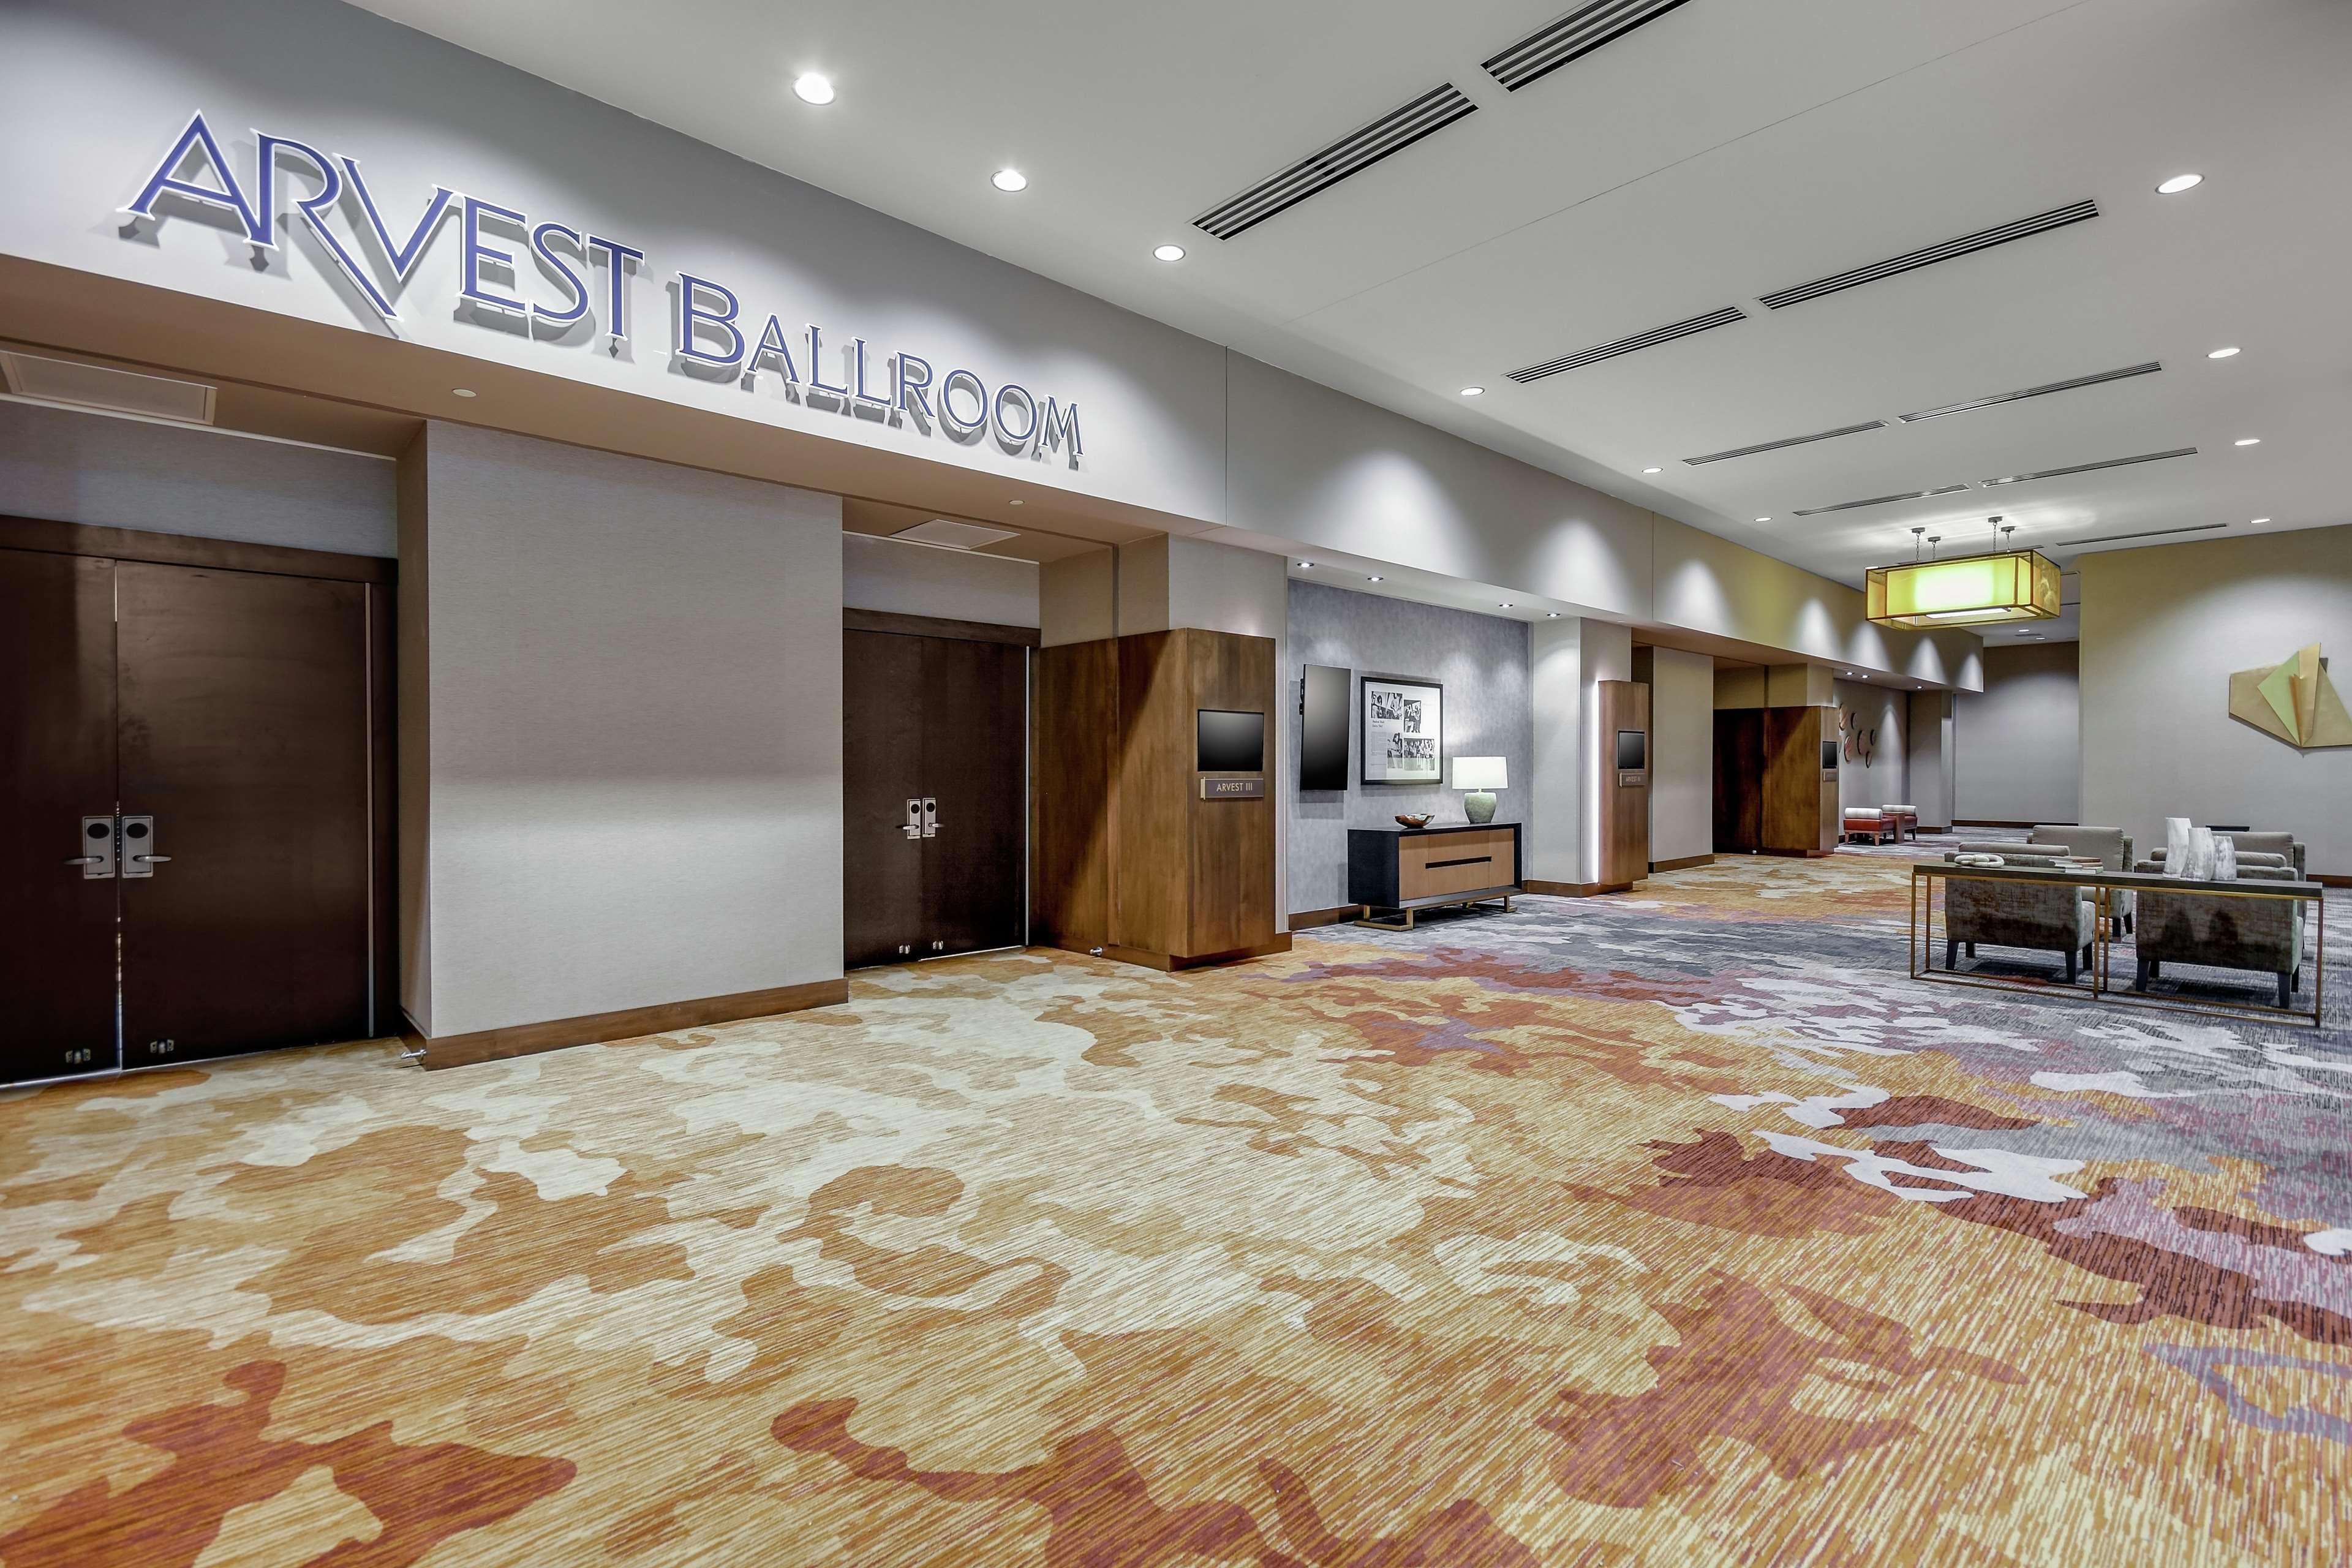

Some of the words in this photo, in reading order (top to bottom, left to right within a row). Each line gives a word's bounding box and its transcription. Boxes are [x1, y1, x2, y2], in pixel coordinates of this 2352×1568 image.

[117, 109, 645, 341] ARVEST
[676, 270, 1085, 456] BALLROOM
[1216, 783, 1243, 792] ARVEST
